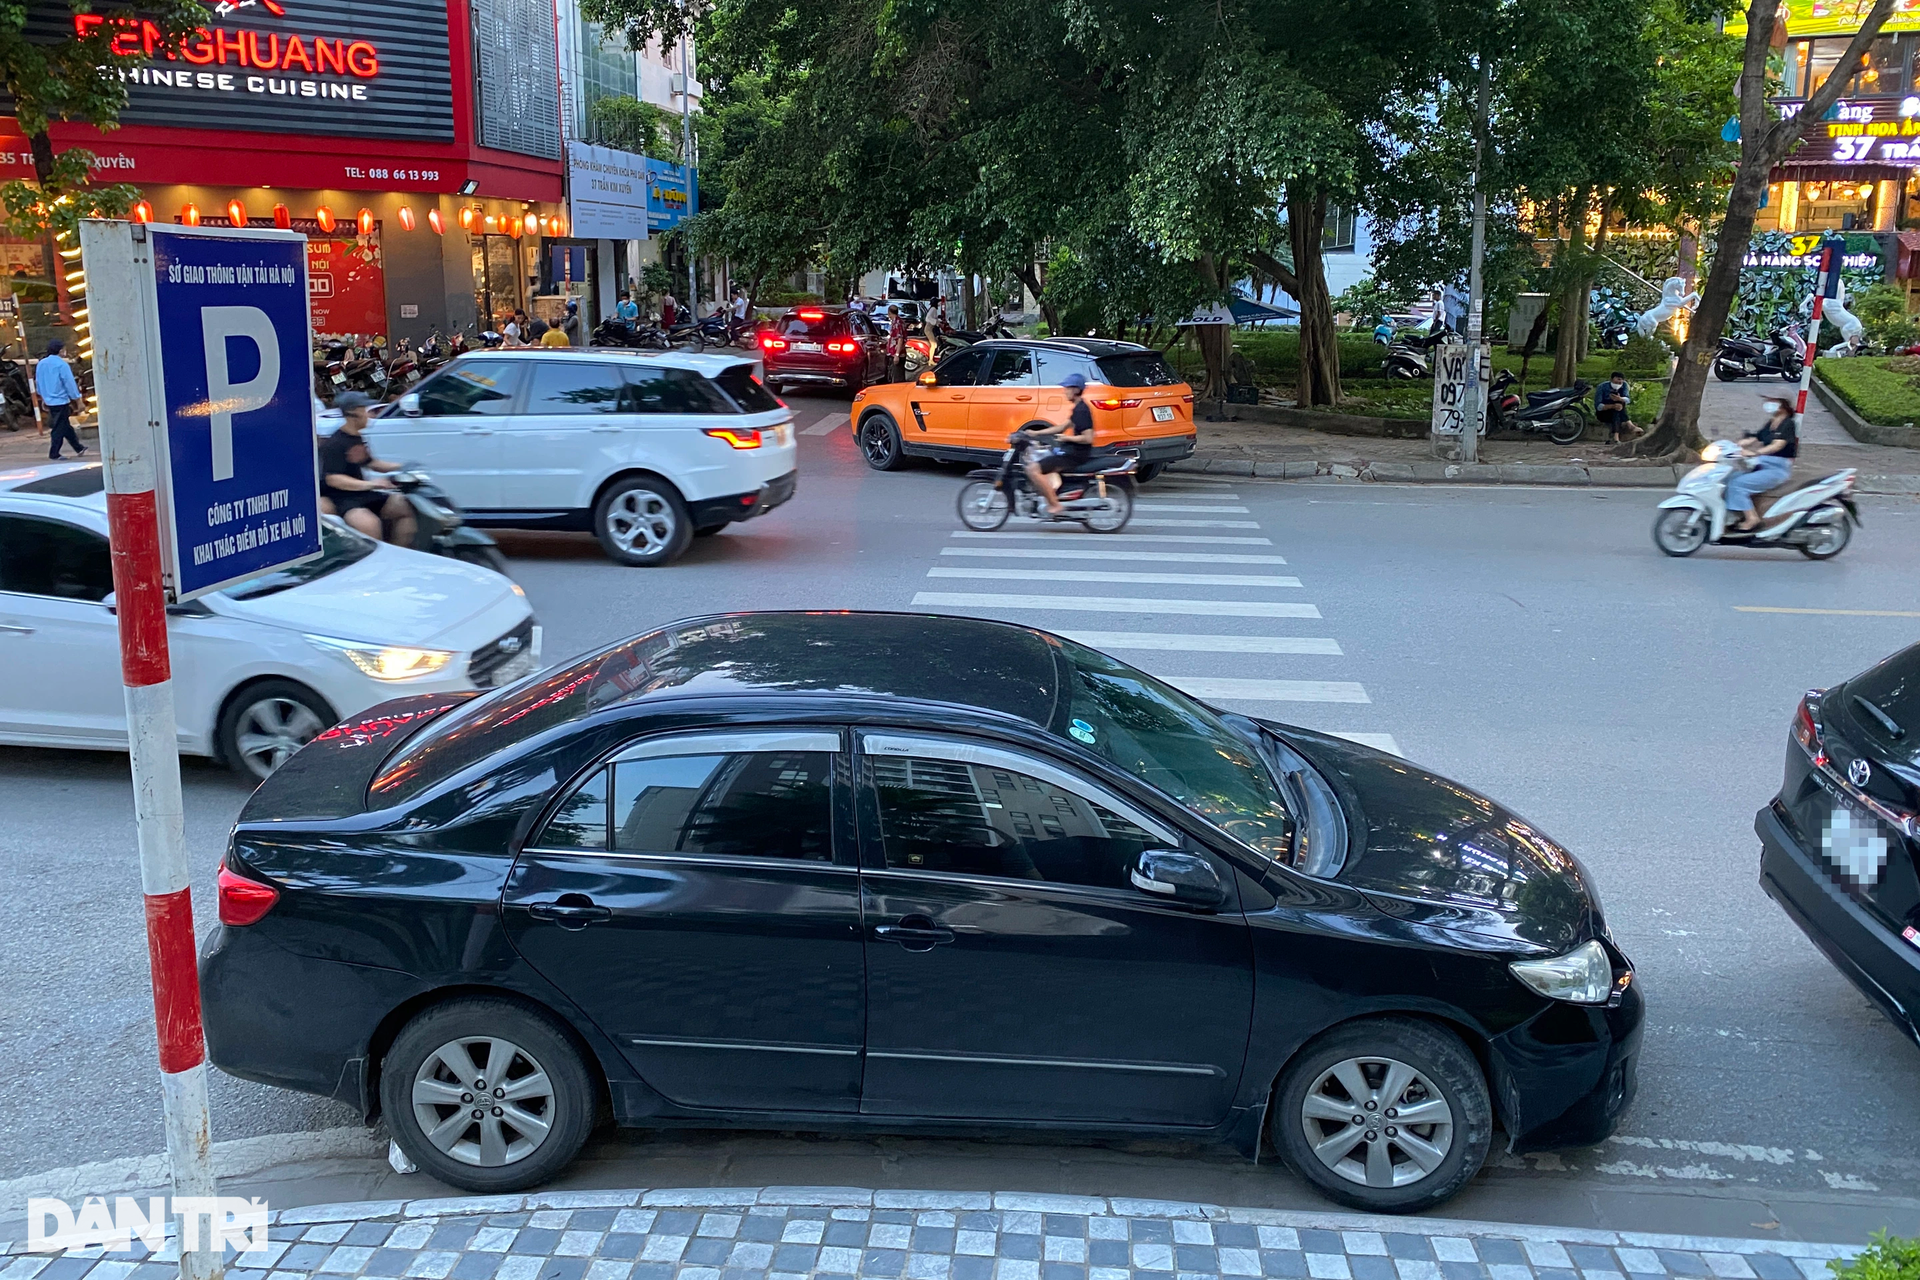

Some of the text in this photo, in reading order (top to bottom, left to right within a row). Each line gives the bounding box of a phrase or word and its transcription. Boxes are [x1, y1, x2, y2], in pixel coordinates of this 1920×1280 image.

[247, 75, 368, 101] CUISINE
[1827, 122, 1864, 138] TINH
[1866, 122, 1899, 137] HOA
[1833, 136, 1877, 160] 37
[345, 166, 439, 181] TEL: 088 66 13 993
[591, 179, 597, 190] 37
[610, 181, 618, 193] KIM
[1790, 235, 1821, 256] 37
[1761, 251, 1802, 267] HÀNG
[168, 257, 295, 288] SỞ GIAO THÔNG VẬN TẢI HÀ NỘI
[200, 306, 282, 481] P
[207, 489, 289, 527] CÔNG TY TNHH MTV
[193, 512, 306, 566] KHAI THÁC ĐIỂM ĐỖ XE HÀ NỘI
